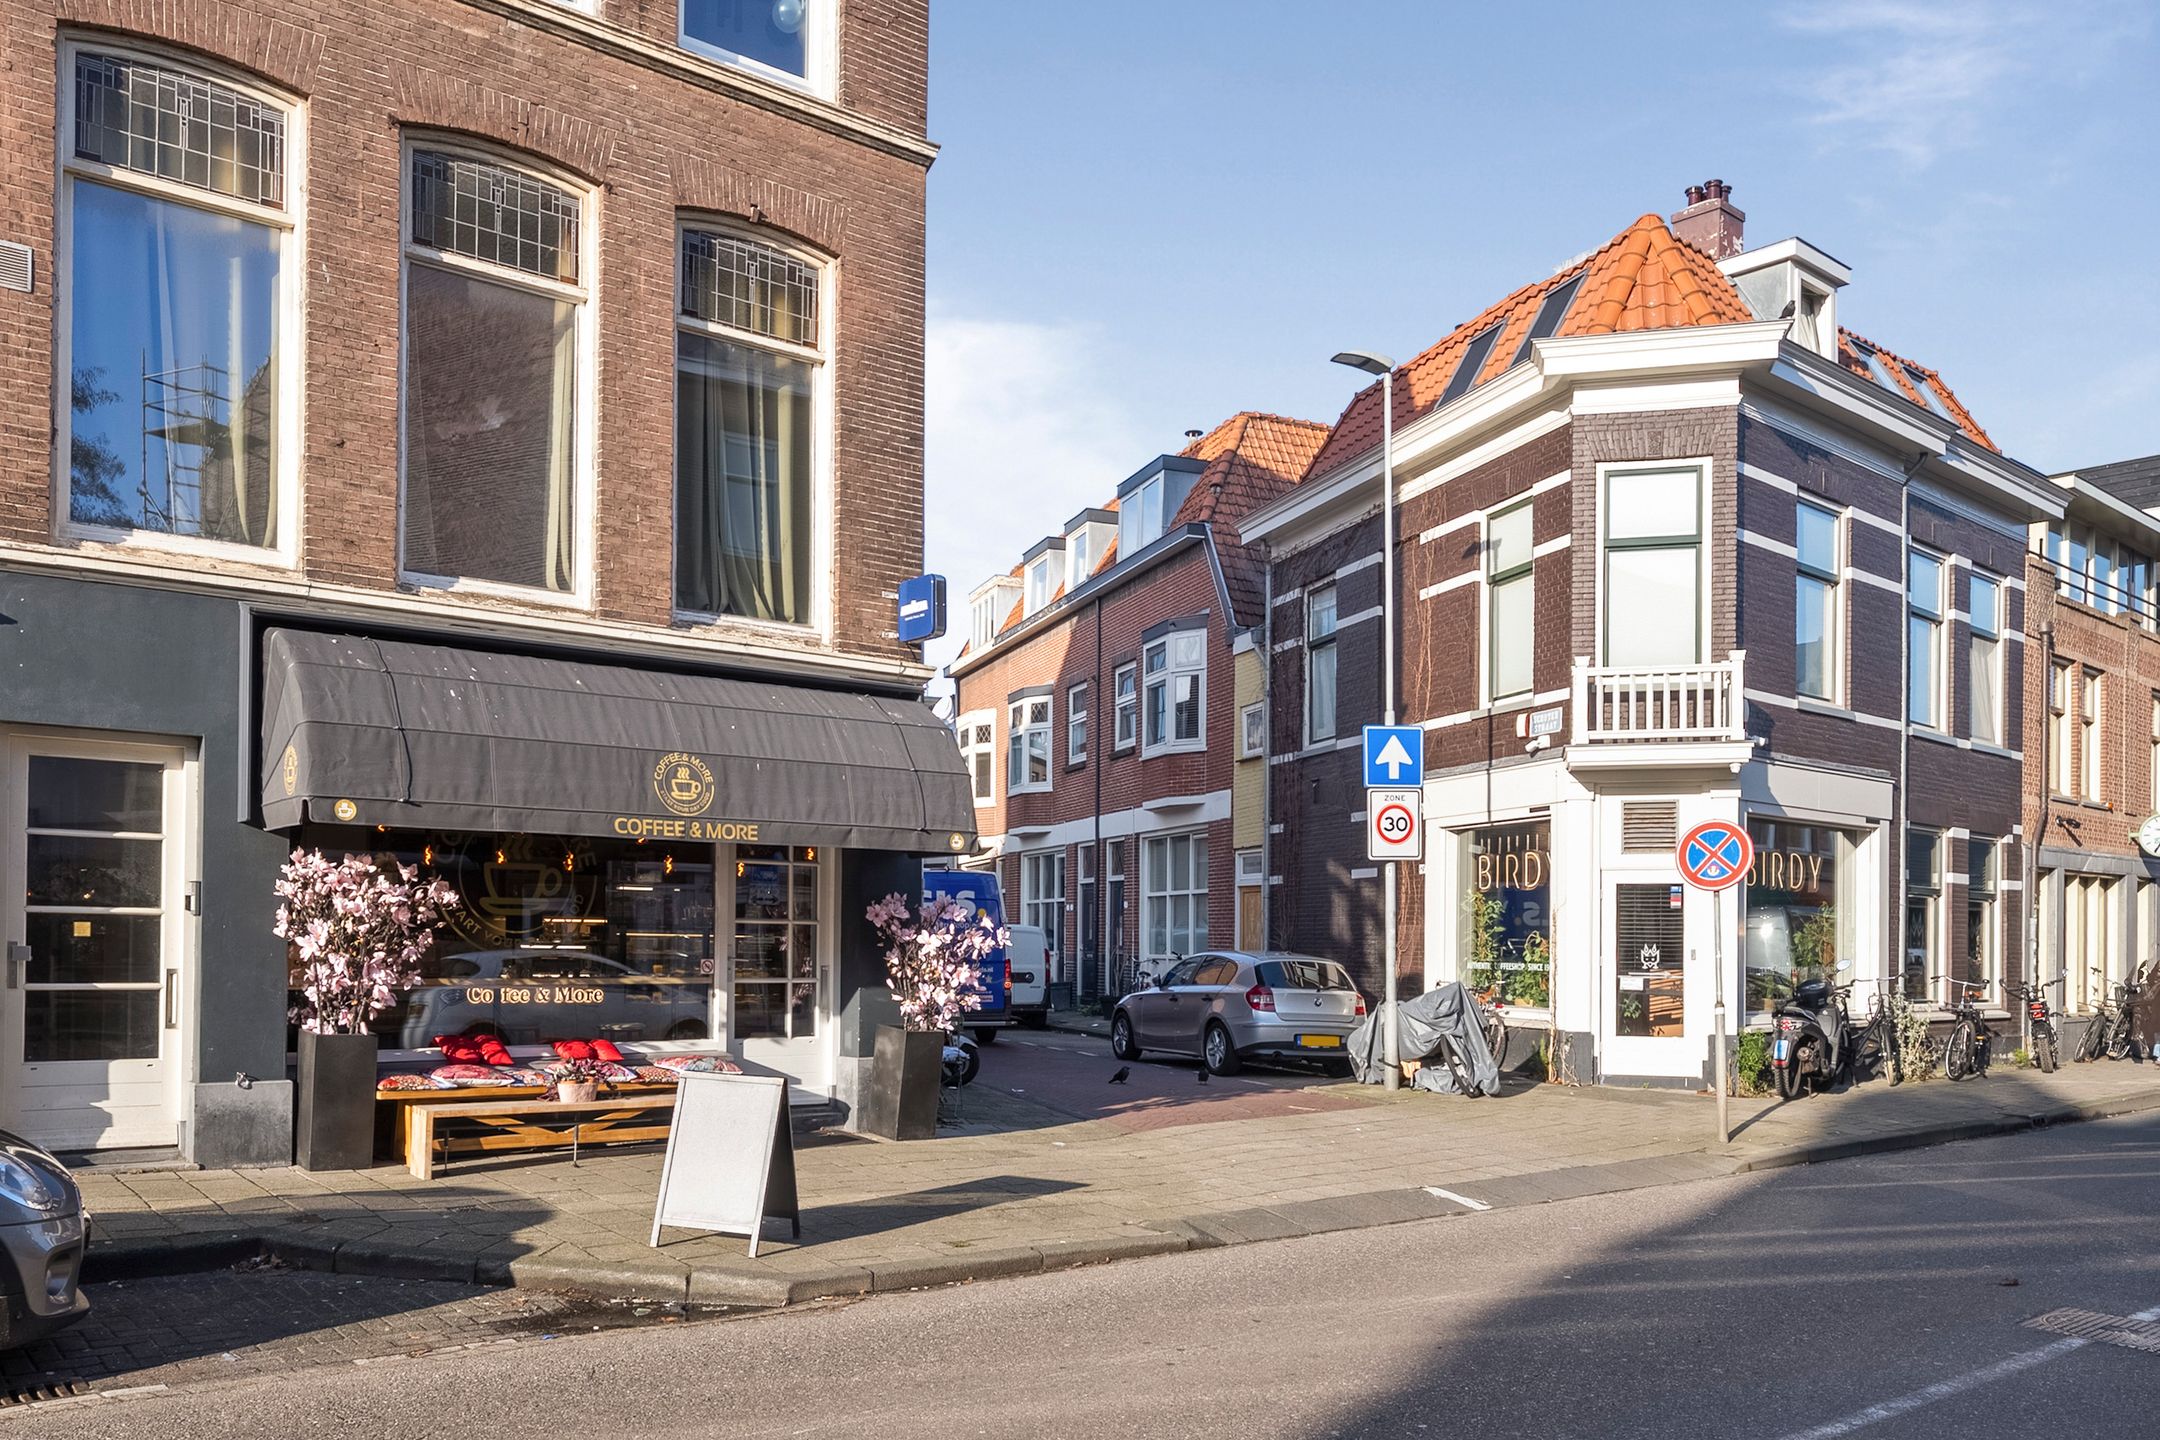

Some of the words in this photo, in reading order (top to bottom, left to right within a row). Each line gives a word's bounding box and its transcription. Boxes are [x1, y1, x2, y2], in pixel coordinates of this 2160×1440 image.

[654, 752, 682, 780] COFFEE
[682, 753, 689, 761] &
[690, 756, 714, 783] MORE
[1384, 794, 1406, 802] ZONE
[614, 817, 686, 837] COFFEE
[689, 821, 702, 839] &
[706, 822, 759, 841] MORE
[1383, 816, 1408, 832] 30
[533, 987, 551, 1004] &
[554, 987, 604, 1004] More
